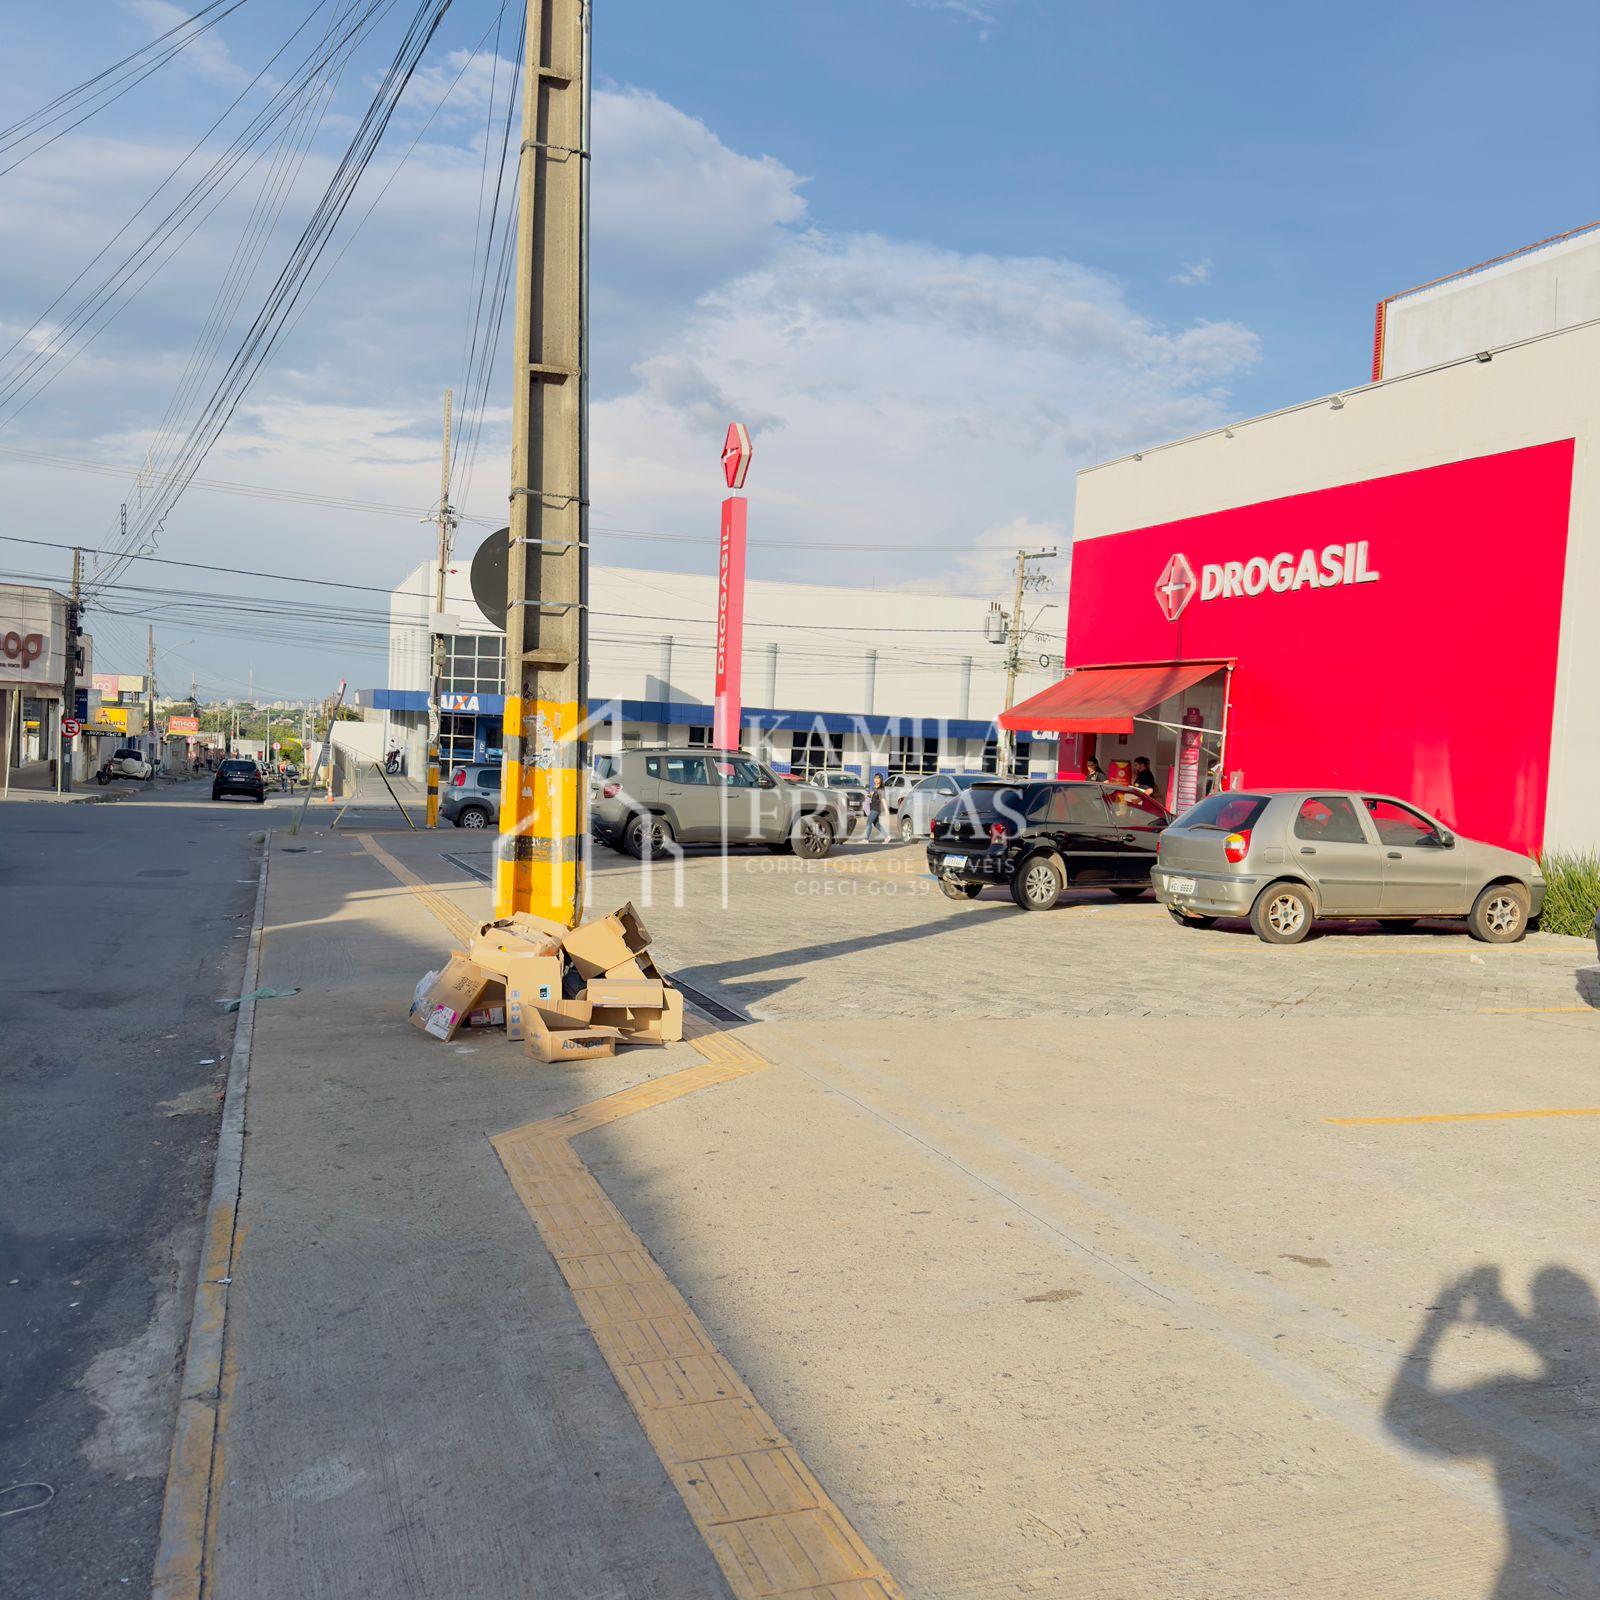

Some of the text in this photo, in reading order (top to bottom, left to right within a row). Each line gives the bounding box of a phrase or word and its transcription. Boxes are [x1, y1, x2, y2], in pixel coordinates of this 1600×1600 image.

[717, 524, 730, 675] DROGASIL
[1201, 540, 1380, 601] DROGASIL
[0, 631, 43, 669] op
